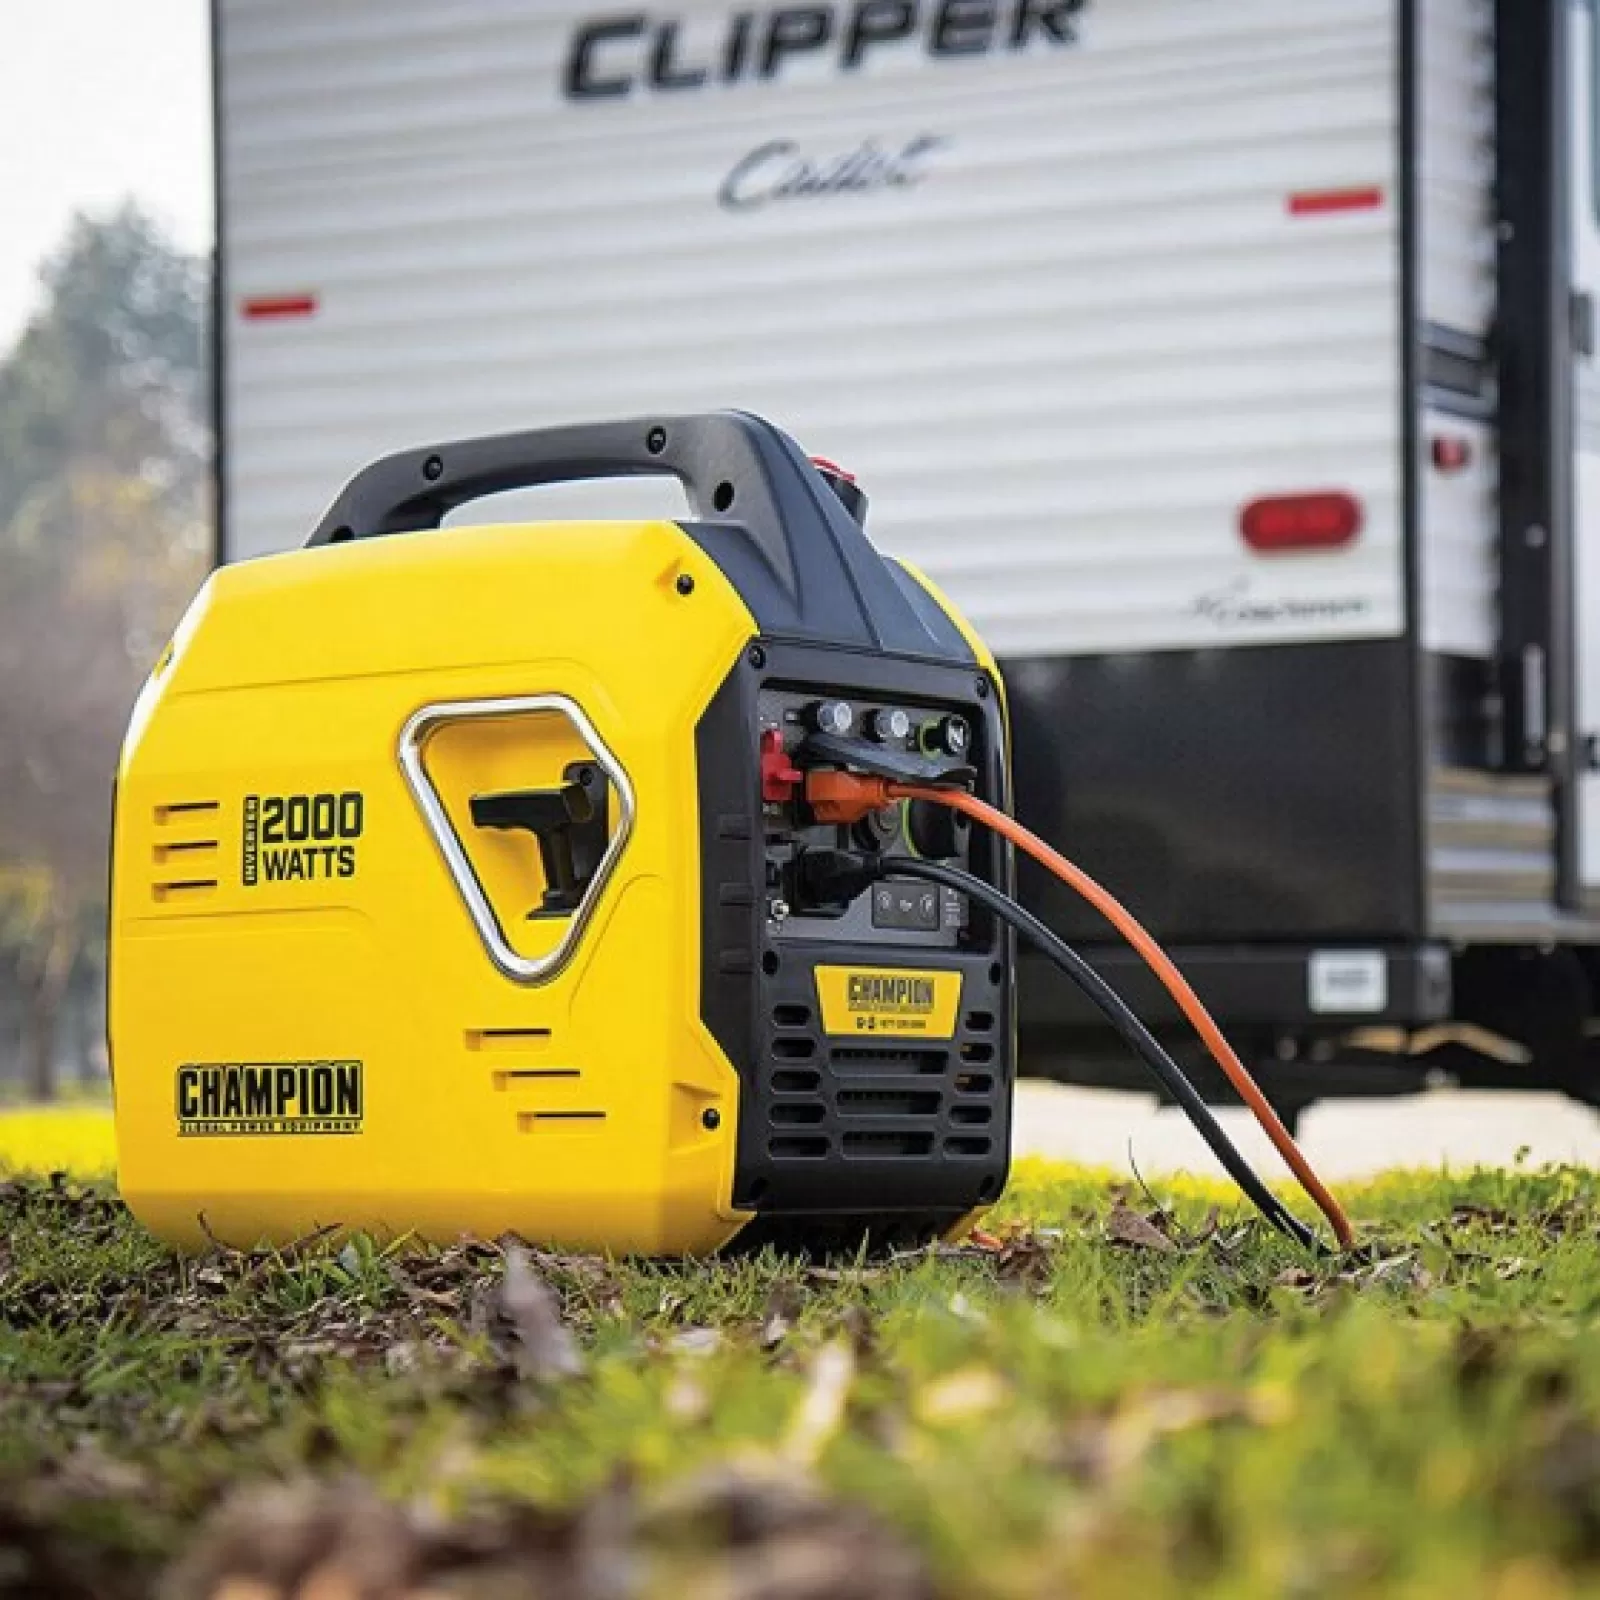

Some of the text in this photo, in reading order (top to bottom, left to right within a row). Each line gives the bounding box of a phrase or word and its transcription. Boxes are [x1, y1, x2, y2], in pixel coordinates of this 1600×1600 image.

[562, 0, 1086, 101] CLIPPER
[262, 792, 363, 843] 2000
[262, 846, 355, 880] WATTS
[179, 1066, 359, 1118] CHAMPION
